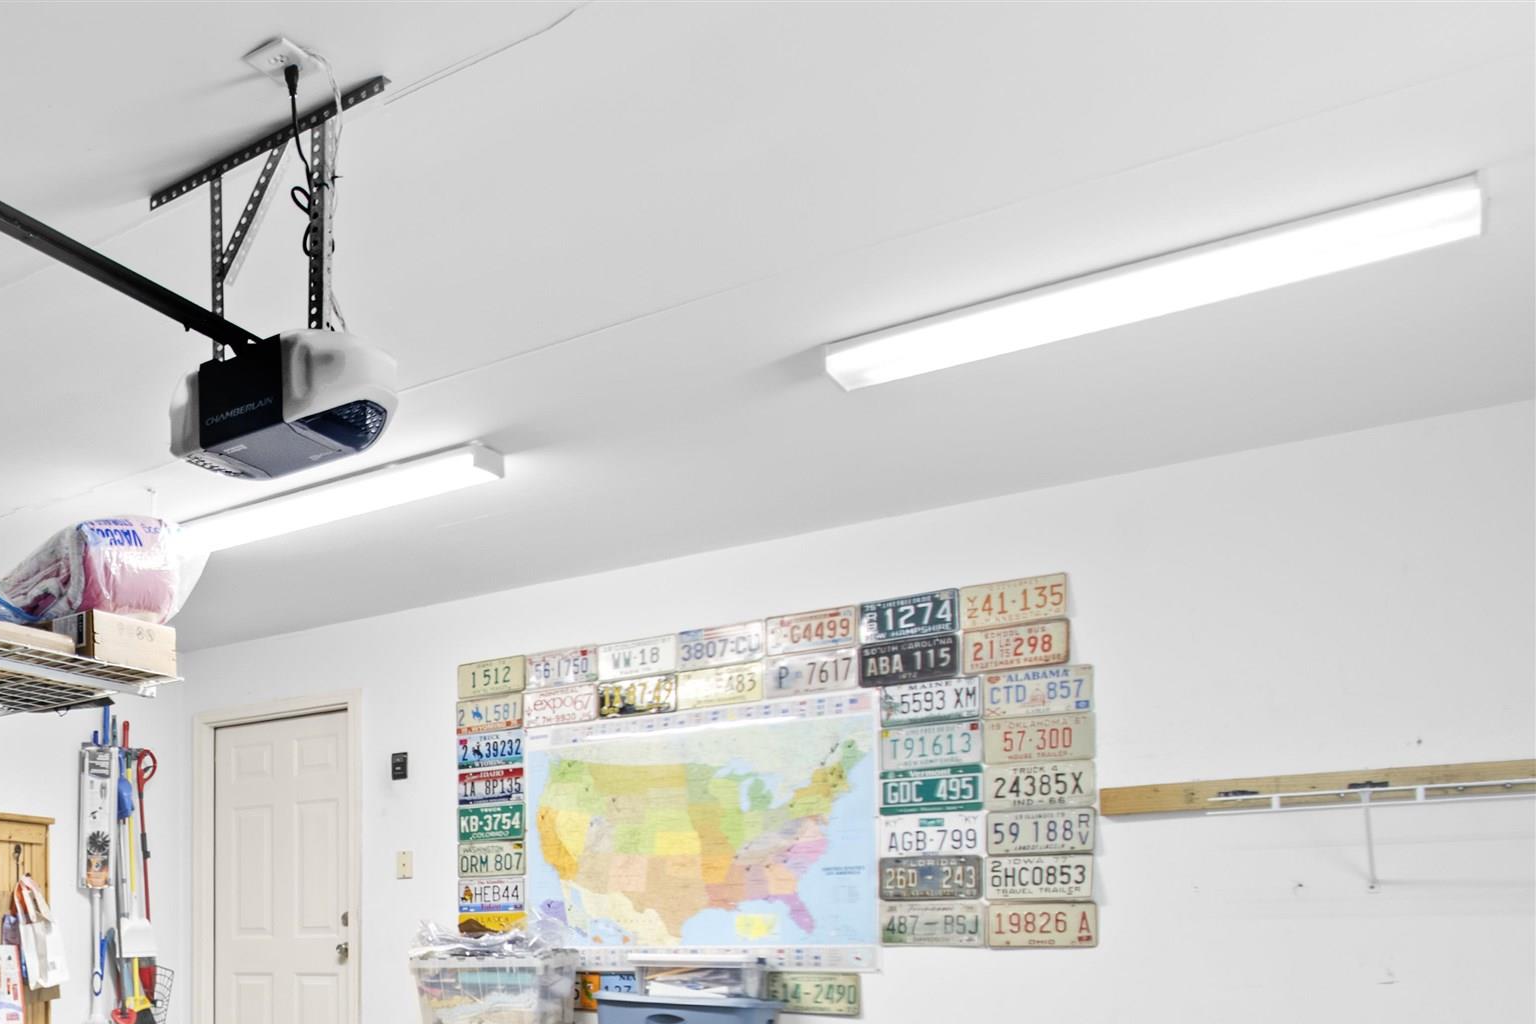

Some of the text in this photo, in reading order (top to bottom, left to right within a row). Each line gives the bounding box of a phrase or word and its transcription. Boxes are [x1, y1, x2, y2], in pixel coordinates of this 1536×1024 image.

[885, 599, 953, 631] 1274
[863, 644, 898, 656] SOUTH
[973, 640, 994, 662] 21
[1013, 634, 1053, 657] 298
[778, 656, 852, 689] P 7617
[866, 647, 951, 677] ABA 115
[908, 681, 952, 690] MAINE
[1006, 668, 1070, 683] ALABAMA
[900, 686, 977, 715] 5593 XM
[990, 678, 1085, 705] CTD 857
[462, 738, 521, 761] 2 39232
[889, 731, 972, 760] T91613
[1012, 766, 1044, 774] TRUCK
[463, 781, 476, 798] 1A
[935, 776, 974, 801] 495
[994, 771, 1084, 799] 24385X
[993, 819, 1073, 845] 59 188
[494, 852, 523, 872] 807
[1008, 857, 1045, 865] IOWA
[474, 884, 519, 903] HEB44
[996, 886, 1081, 896] TRAVEL TRAILER
[994, 911, 1091, 935] 19826 A
